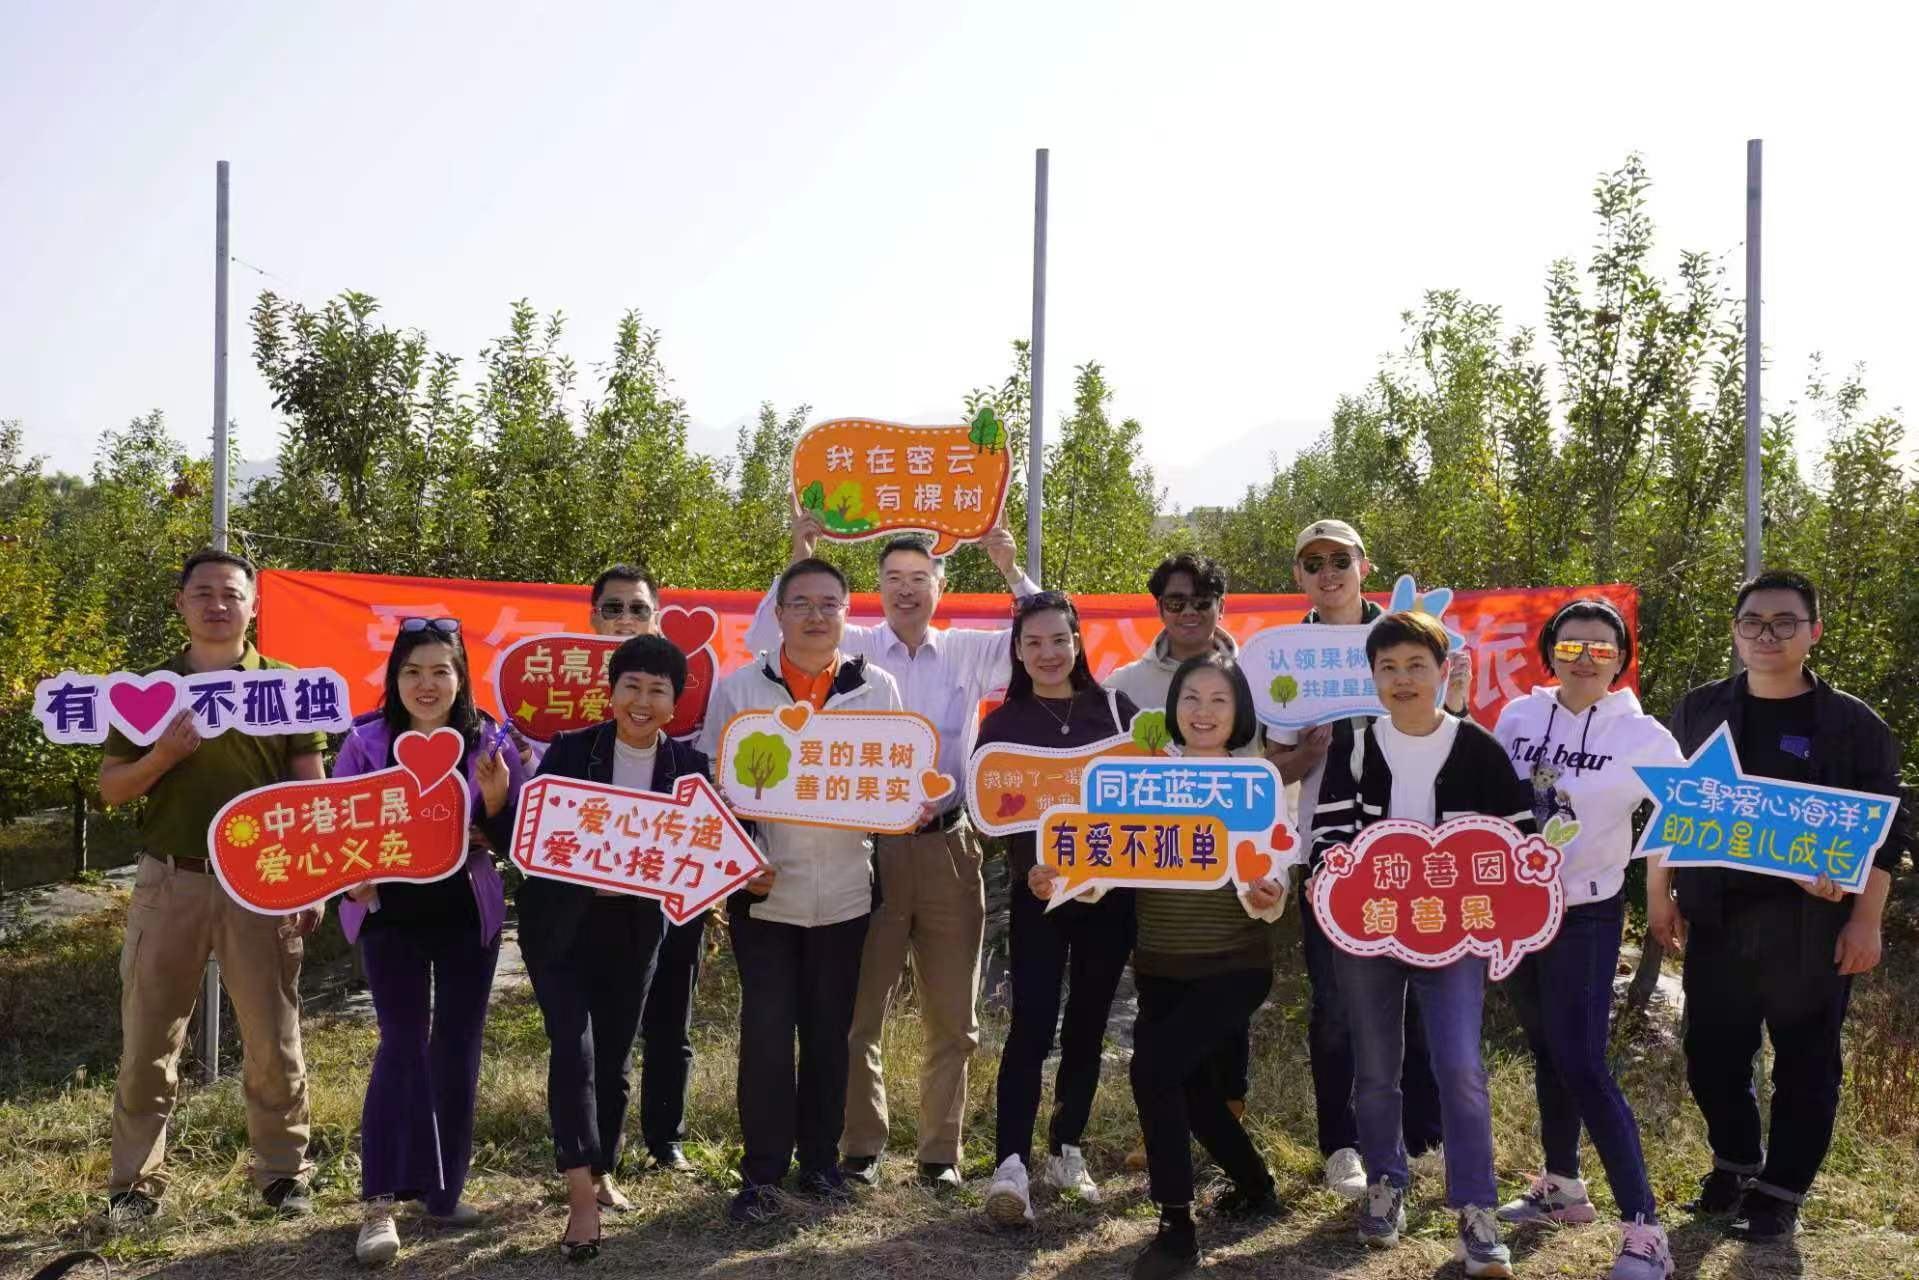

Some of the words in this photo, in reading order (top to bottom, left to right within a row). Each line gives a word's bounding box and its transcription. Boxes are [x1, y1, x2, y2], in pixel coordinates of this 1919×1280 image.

[826, 444, 976, 475] 我在密云
[875, 484, 983, 512] 有棵树
[46, 682, 99, 733] 有
[189, 676, 342, 728] 不孤独
[799, 740, 915, 769] 爱的果树
[794, 774, 910, 803] 善的果实
[1095, 768, 1270, 809] 同在蓝天下
[1666, 777, 1862, 832] 汇聚爱心海洋
[263, 787, 412, 839] 中港汇晟
[576, 796, 724, 851] 爱心传递
[255, 831, 413, 885] 爱心义卖
[542, 830, 705, 889] 爱心接力
[1050, 822, 1219, 870] 有爱不孤单
[1662, 813, 1856, 874] 助力星儿成长
[1373, 851, 1507, 890] 种善因
[1362, 895, 1496, 935] 结善果
